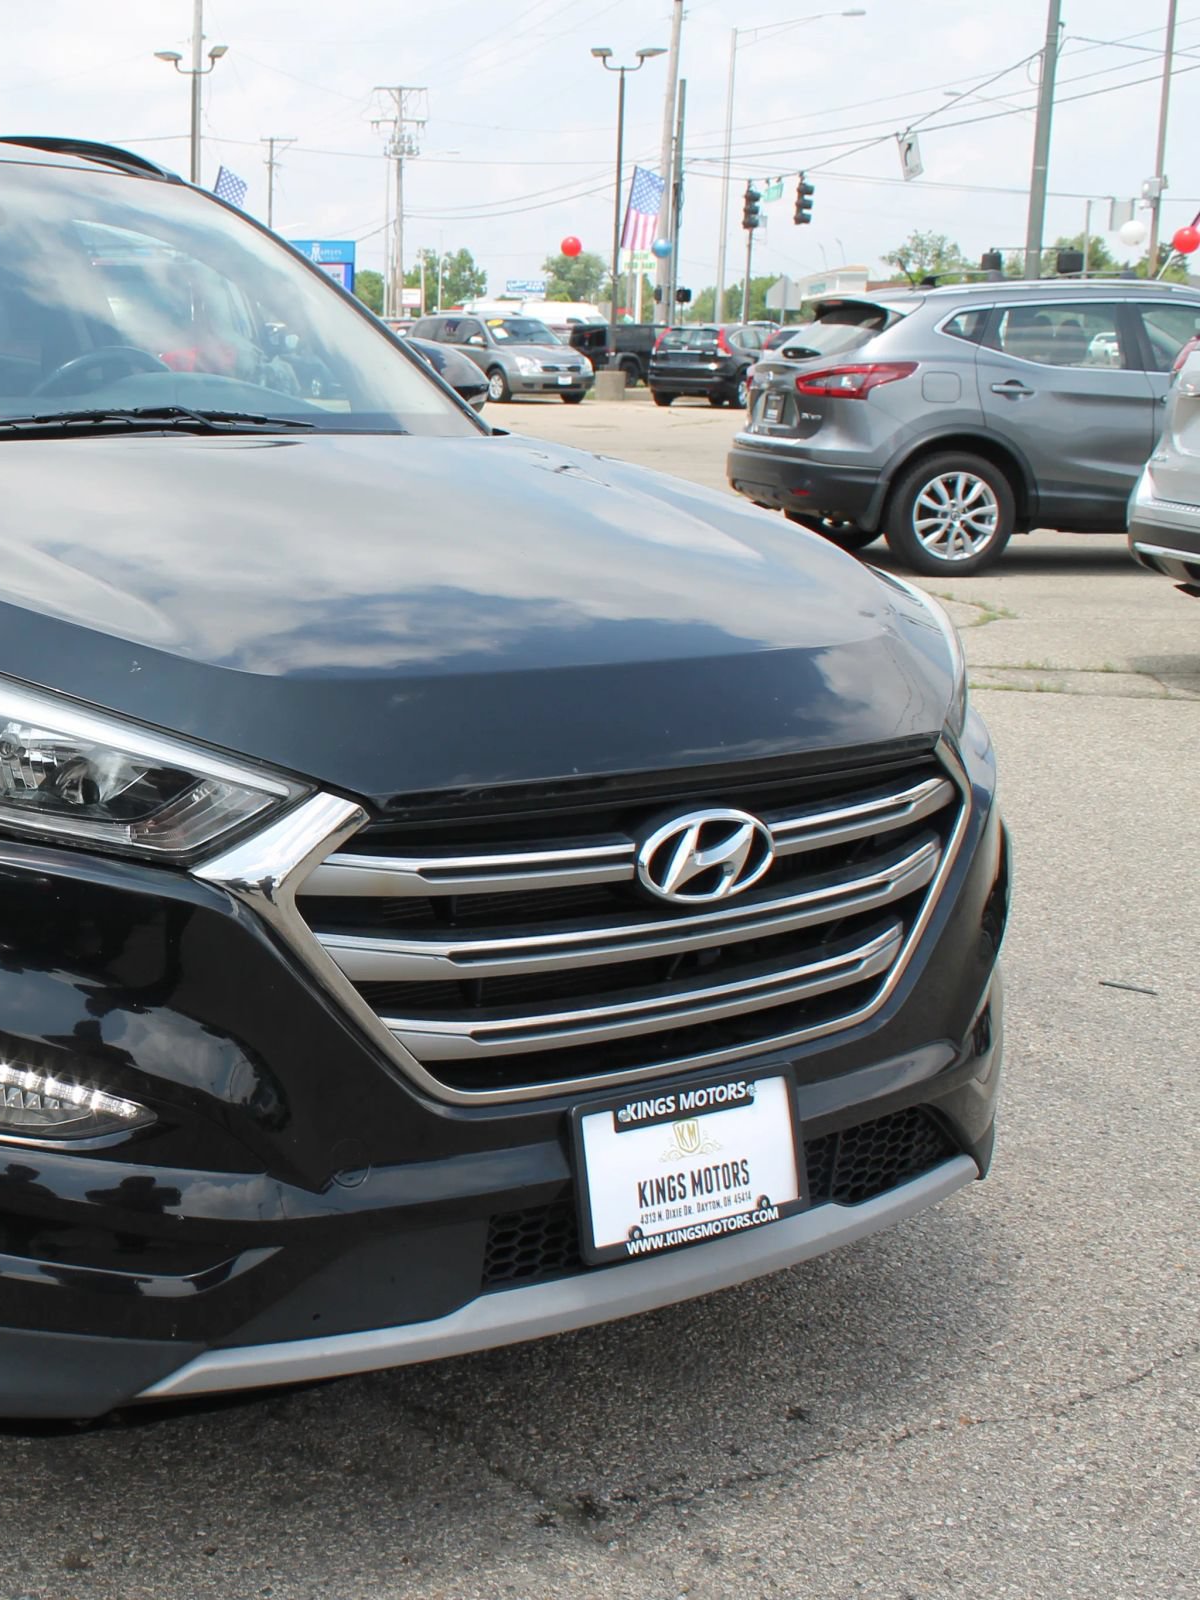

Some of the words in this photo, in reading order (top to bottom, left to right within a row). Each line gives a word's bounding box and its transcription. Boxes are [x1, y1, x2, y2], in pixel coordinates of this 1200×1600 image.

[626, 1095, 676, 1122] KINGS
[679, 1081, 747, 1111] MOTORS
[677, 1125, 697, 1143] KM
[637, 1172, 687, 1208] KINGS
[690, 1159, 750, 1198] MOTORS
[626, 1206, 779, 1256] WWW.KINGSMOTORS.COM
